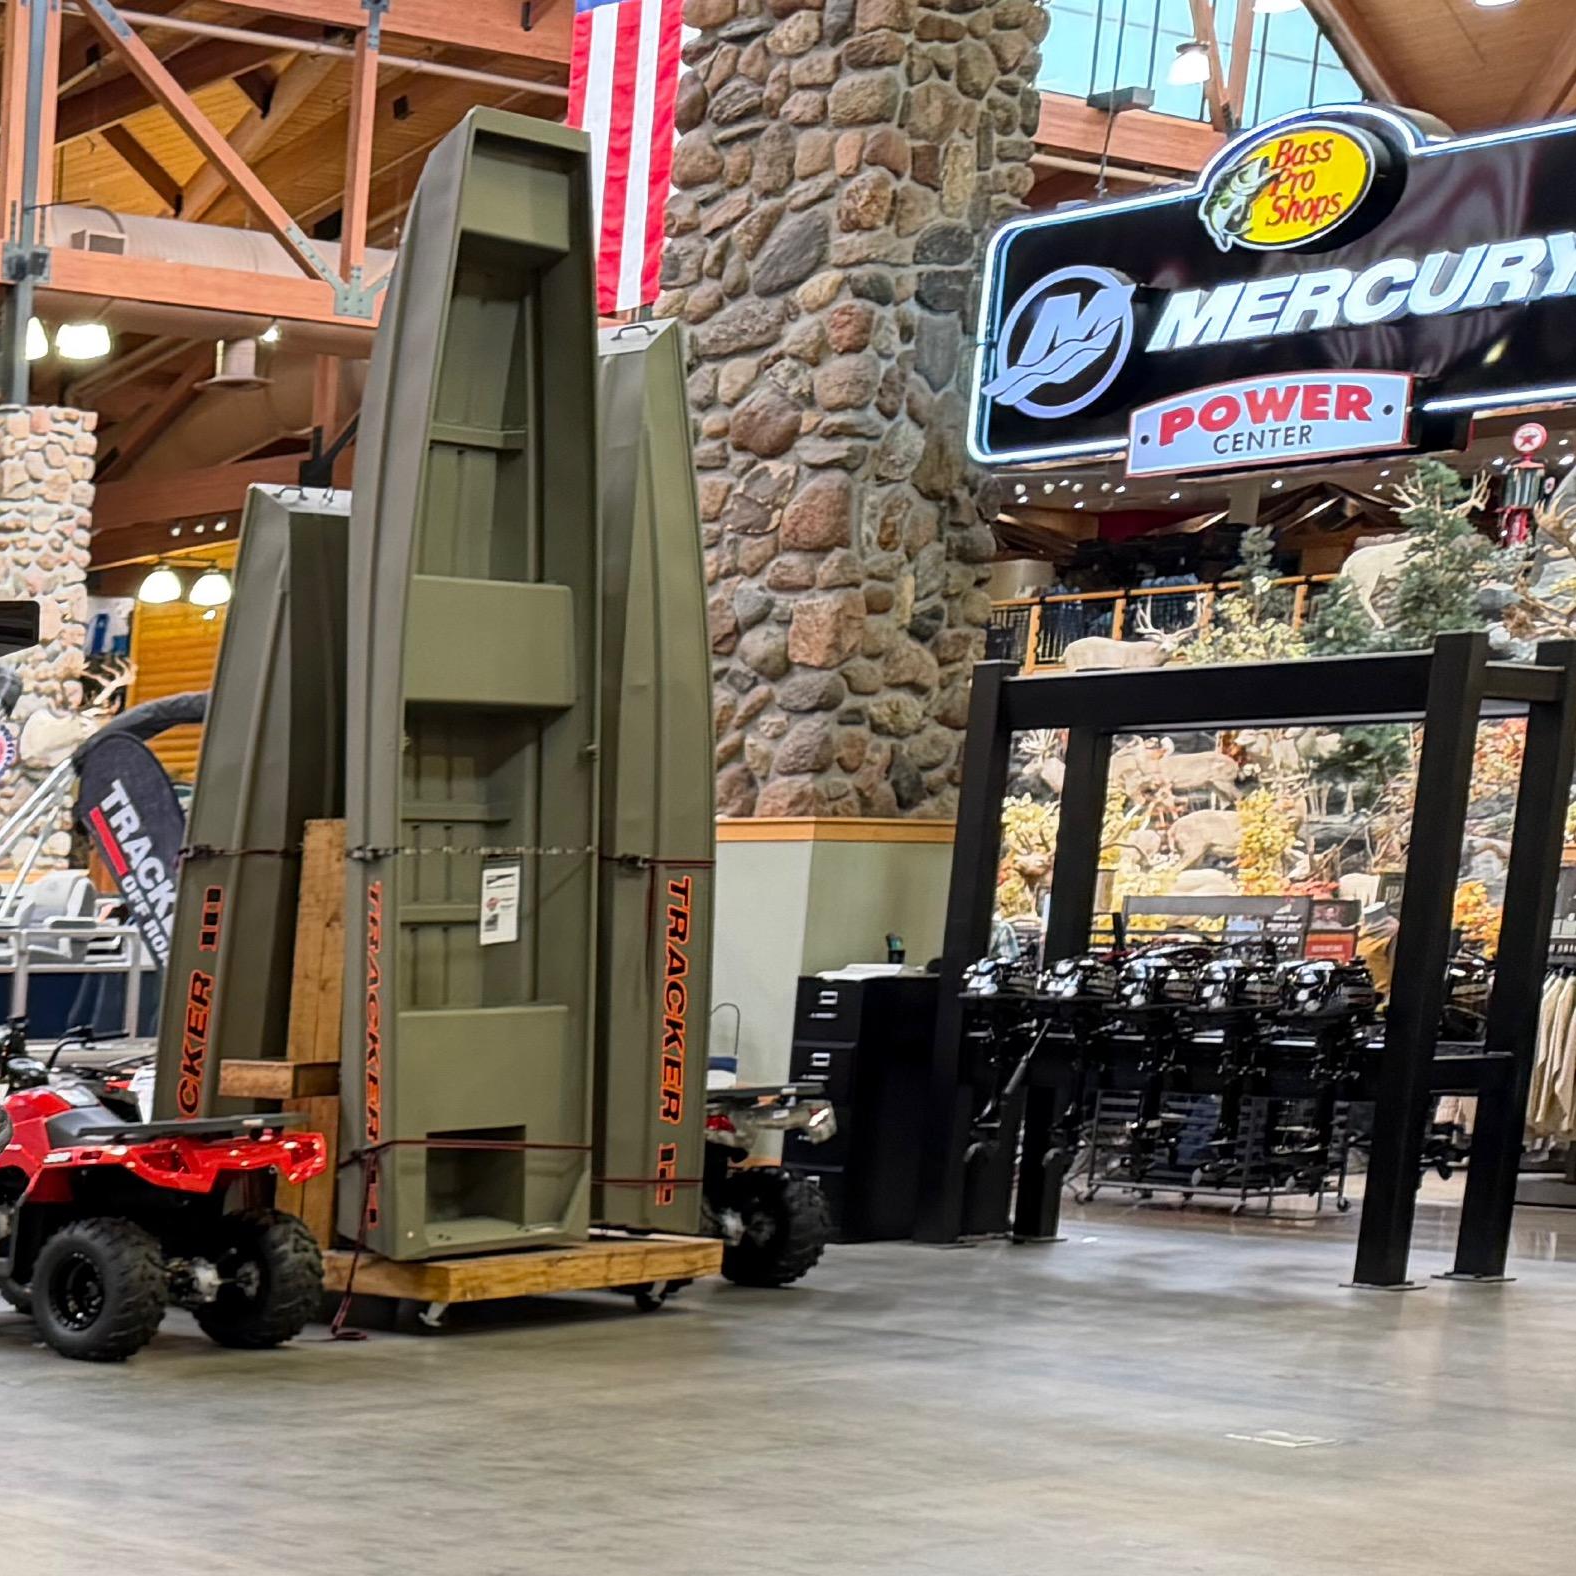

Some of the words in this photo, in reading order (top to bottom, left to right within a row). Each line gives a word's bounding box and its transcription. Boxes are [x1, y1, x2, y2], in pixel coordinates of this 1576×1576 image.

[1271, 138, 1333, 169] Bass
[1270, 169, 1315, 196] Pro
[1266, 192, 1342, 227] Shops
[1159, 384, 1373, 447] POWER
[1213, 424, 1313, 455] CENTER
[101, 779, 177, 941] TRACK
[122, 876, 151, 917] OFF
[659, 875, 692, 1126] TRACKER
[177, 969, 214, 1121] CKER
